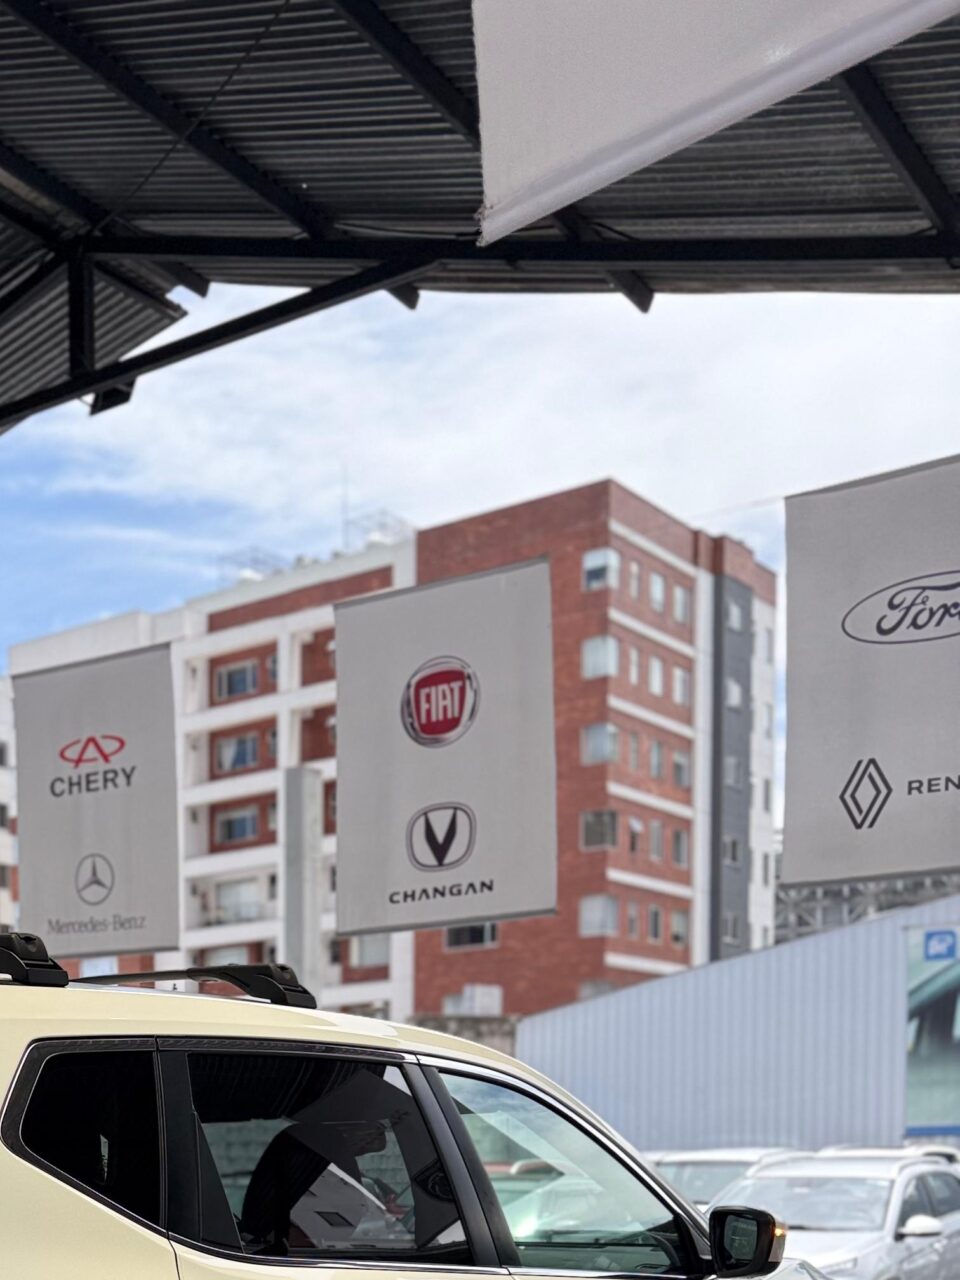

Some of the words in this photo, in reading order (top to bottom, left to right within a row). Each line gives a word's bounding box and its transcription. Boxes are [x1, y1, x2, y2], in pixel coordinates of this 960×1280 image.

[418, 680, 463, 725] FIAT
[49, 765, 137, 798] CHERY
[388, 879, 495, 904] CHANGAN
[47, 913, 147, 935] Mercedes-Benz
